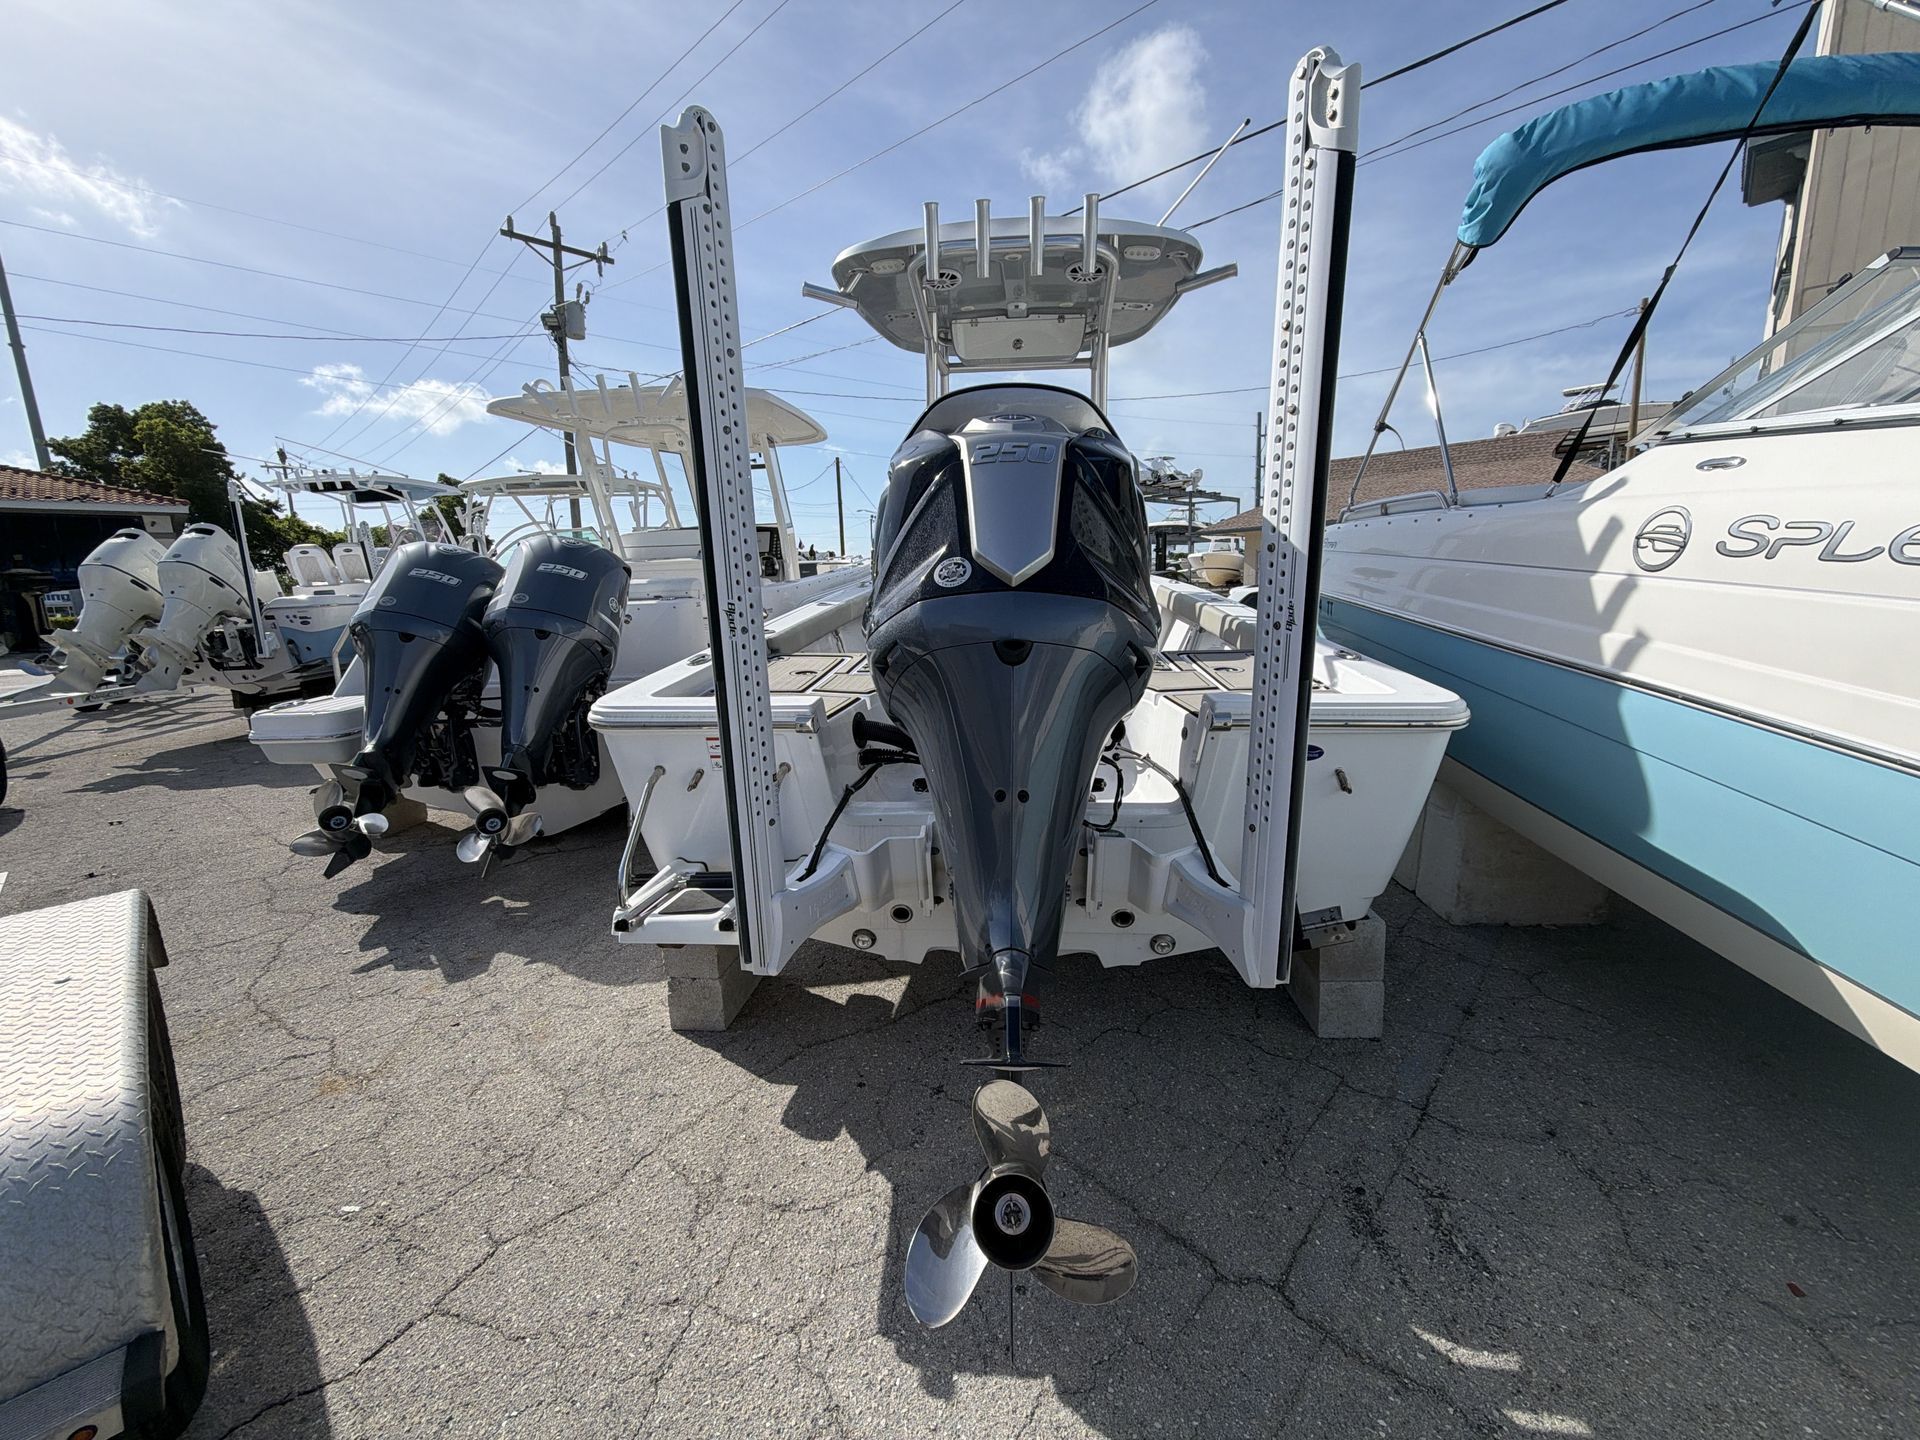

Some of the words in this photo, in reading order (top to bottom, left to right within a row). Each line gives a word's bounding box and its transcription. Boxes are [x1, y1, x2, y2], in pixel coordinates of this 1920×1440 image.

[970, 442, 1058, 466] 250
[407, 567, 463, 588] 250
[535, 562, 589, 581] 250
